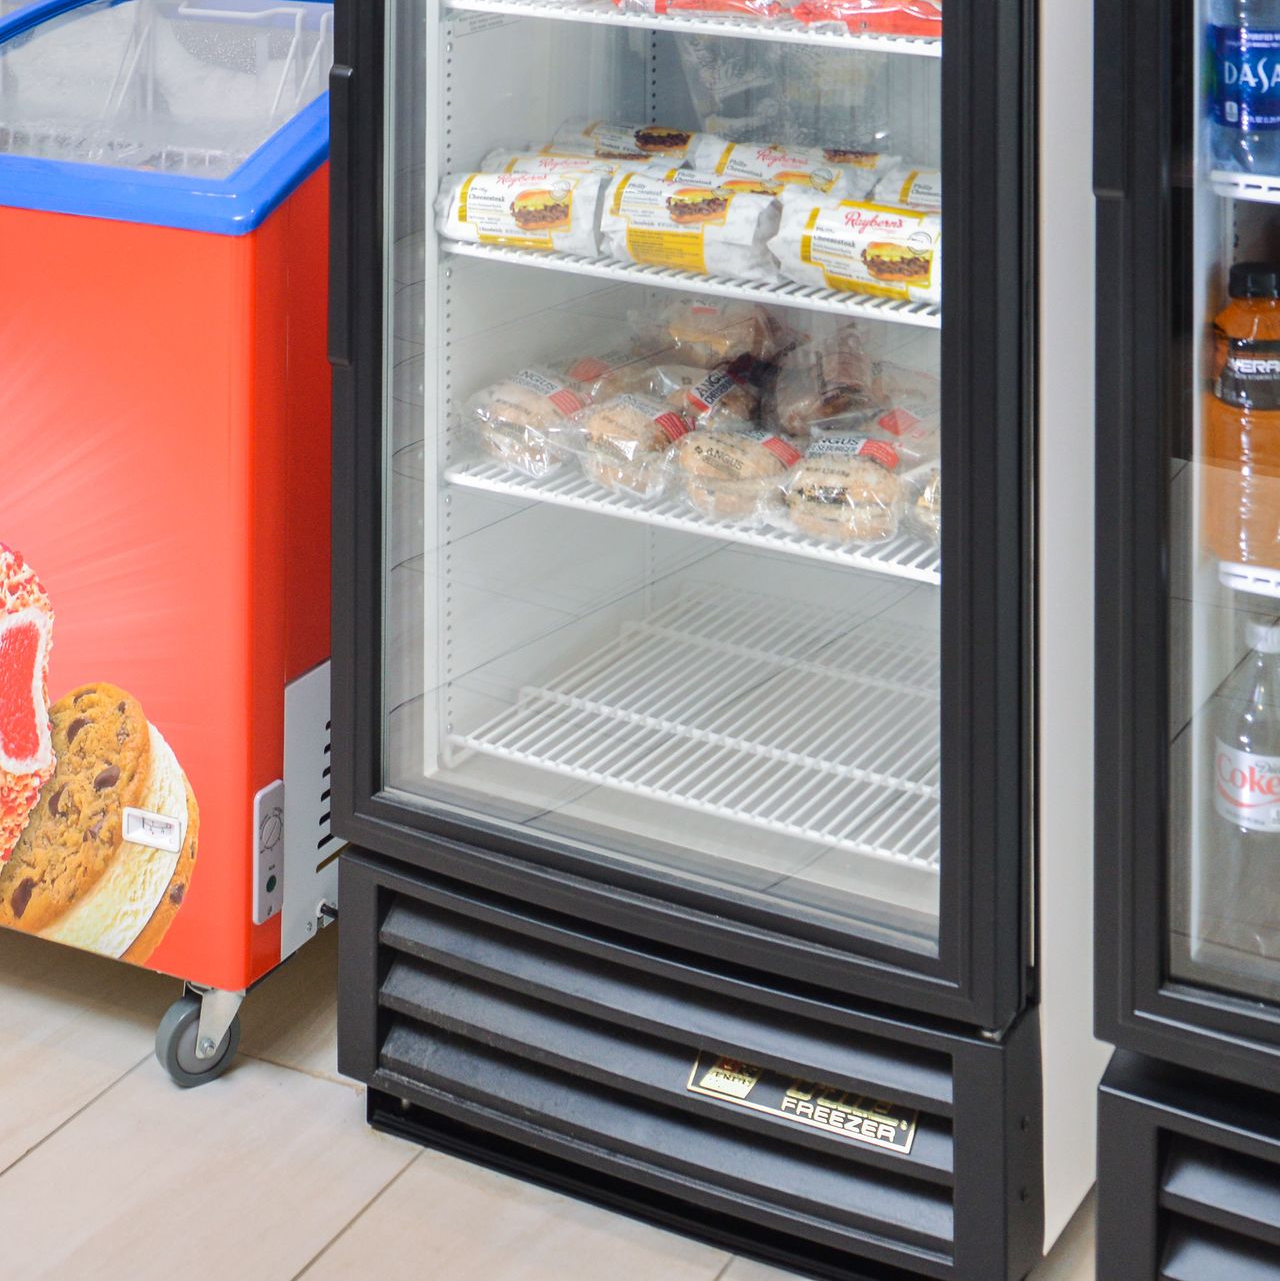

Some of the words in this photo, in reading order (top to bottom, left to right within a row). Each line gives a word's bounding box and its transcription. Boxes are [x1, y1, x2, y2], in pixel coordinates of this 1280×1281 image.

[520, 369, 560, 392] NGUS
[705, 446, 744, 471] ANGUS
[781, 1096, 896, 1143] FREEZER
